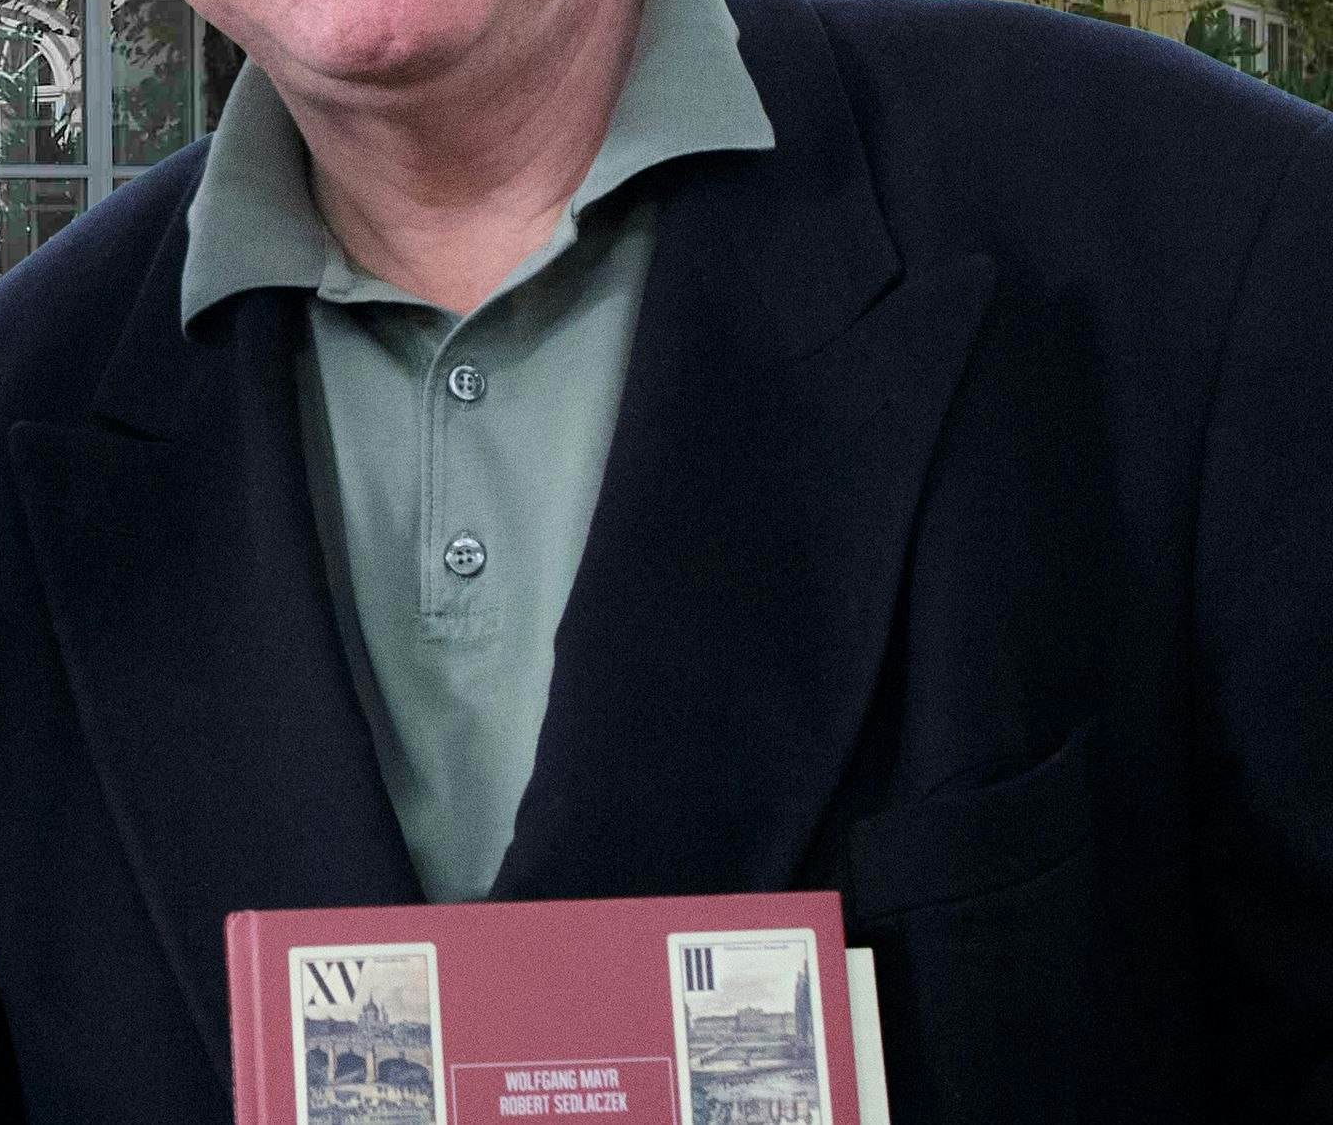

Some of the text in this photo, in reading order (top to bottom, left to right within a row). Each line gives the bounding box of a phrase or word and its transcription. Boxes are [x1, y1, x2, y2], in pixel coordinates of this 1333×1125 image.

[306, 960, 364, 1005] XV
[684, 947, 715, 991] III
[505, 1067, 620, 1092] WOLFGANG MAYR
[499, 1091, 628, 1116] ROBERT SEDLACZEK
